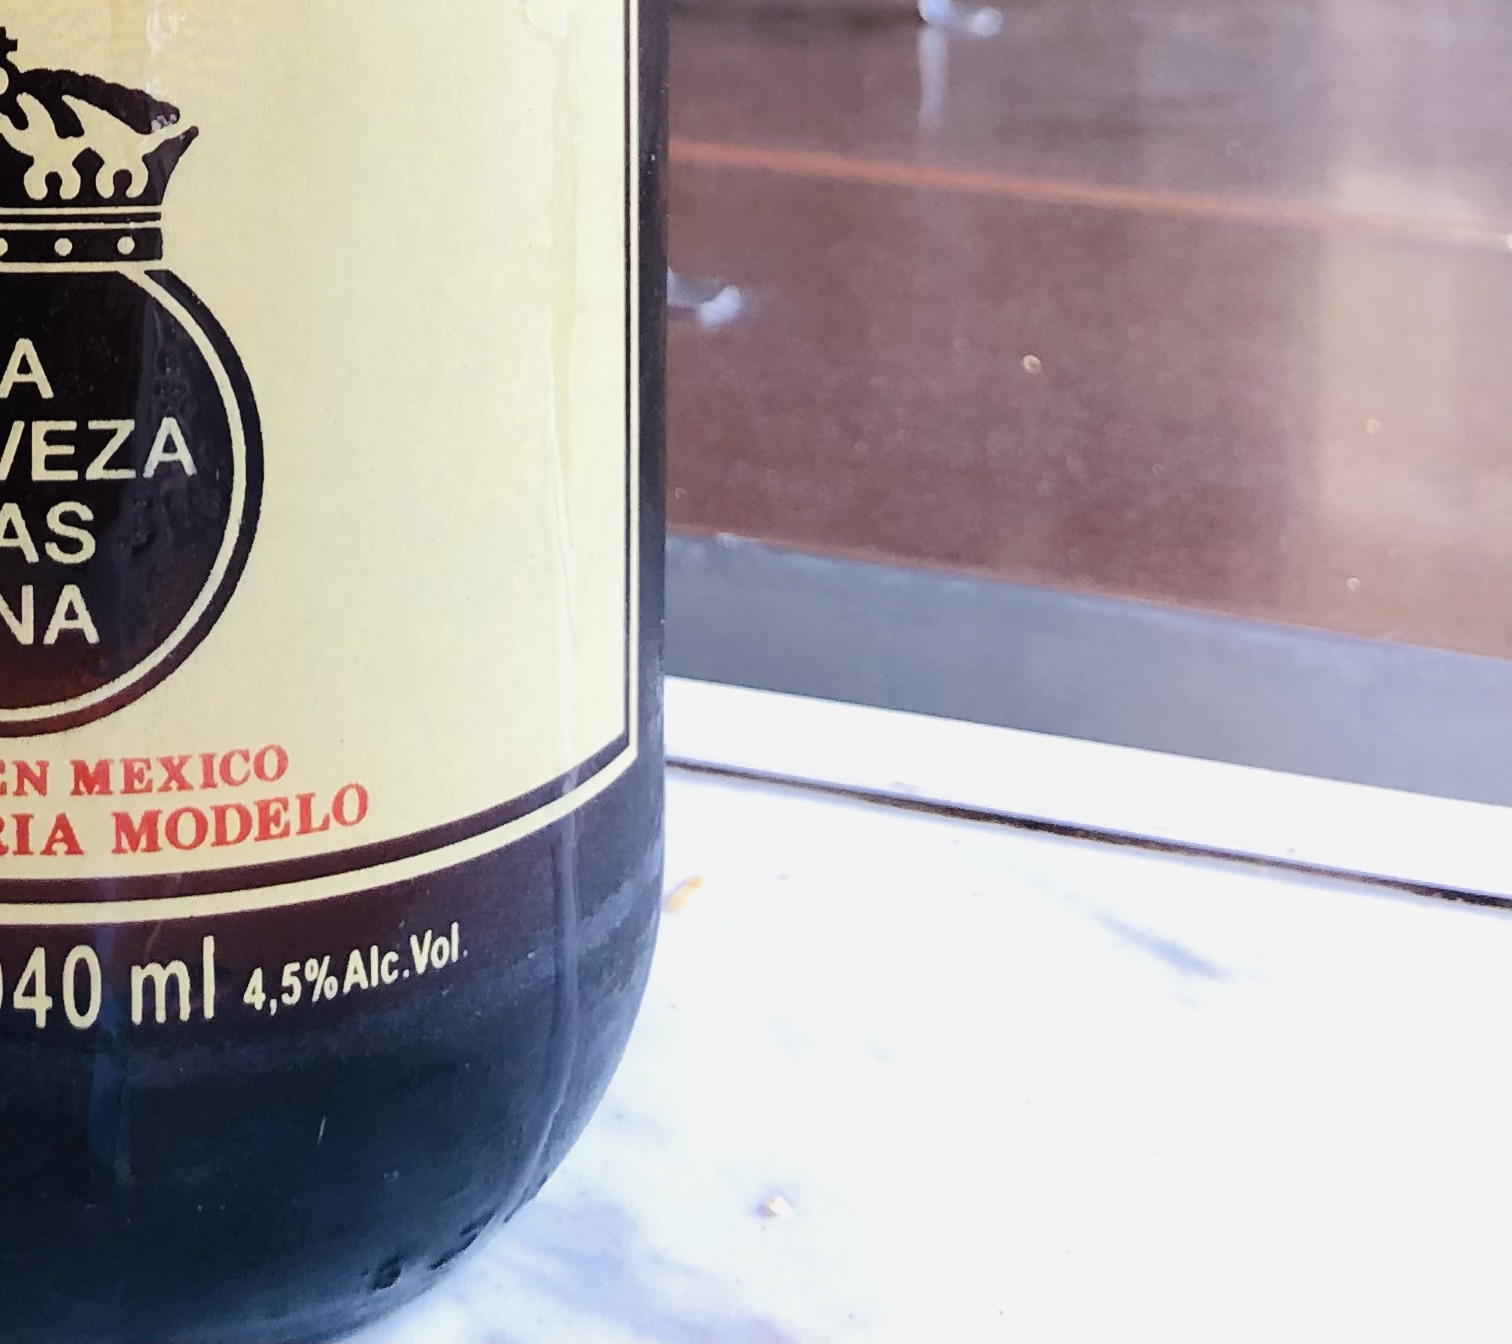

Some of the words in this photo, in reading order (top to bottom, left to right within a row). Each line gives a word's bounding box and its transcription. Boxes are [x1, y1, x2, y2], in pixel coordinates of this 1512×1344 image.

[69, 743, 290, 798] MEXICO
[110, 782, 370, 855] MODELO
[130, 934, 216, 1026] ml
